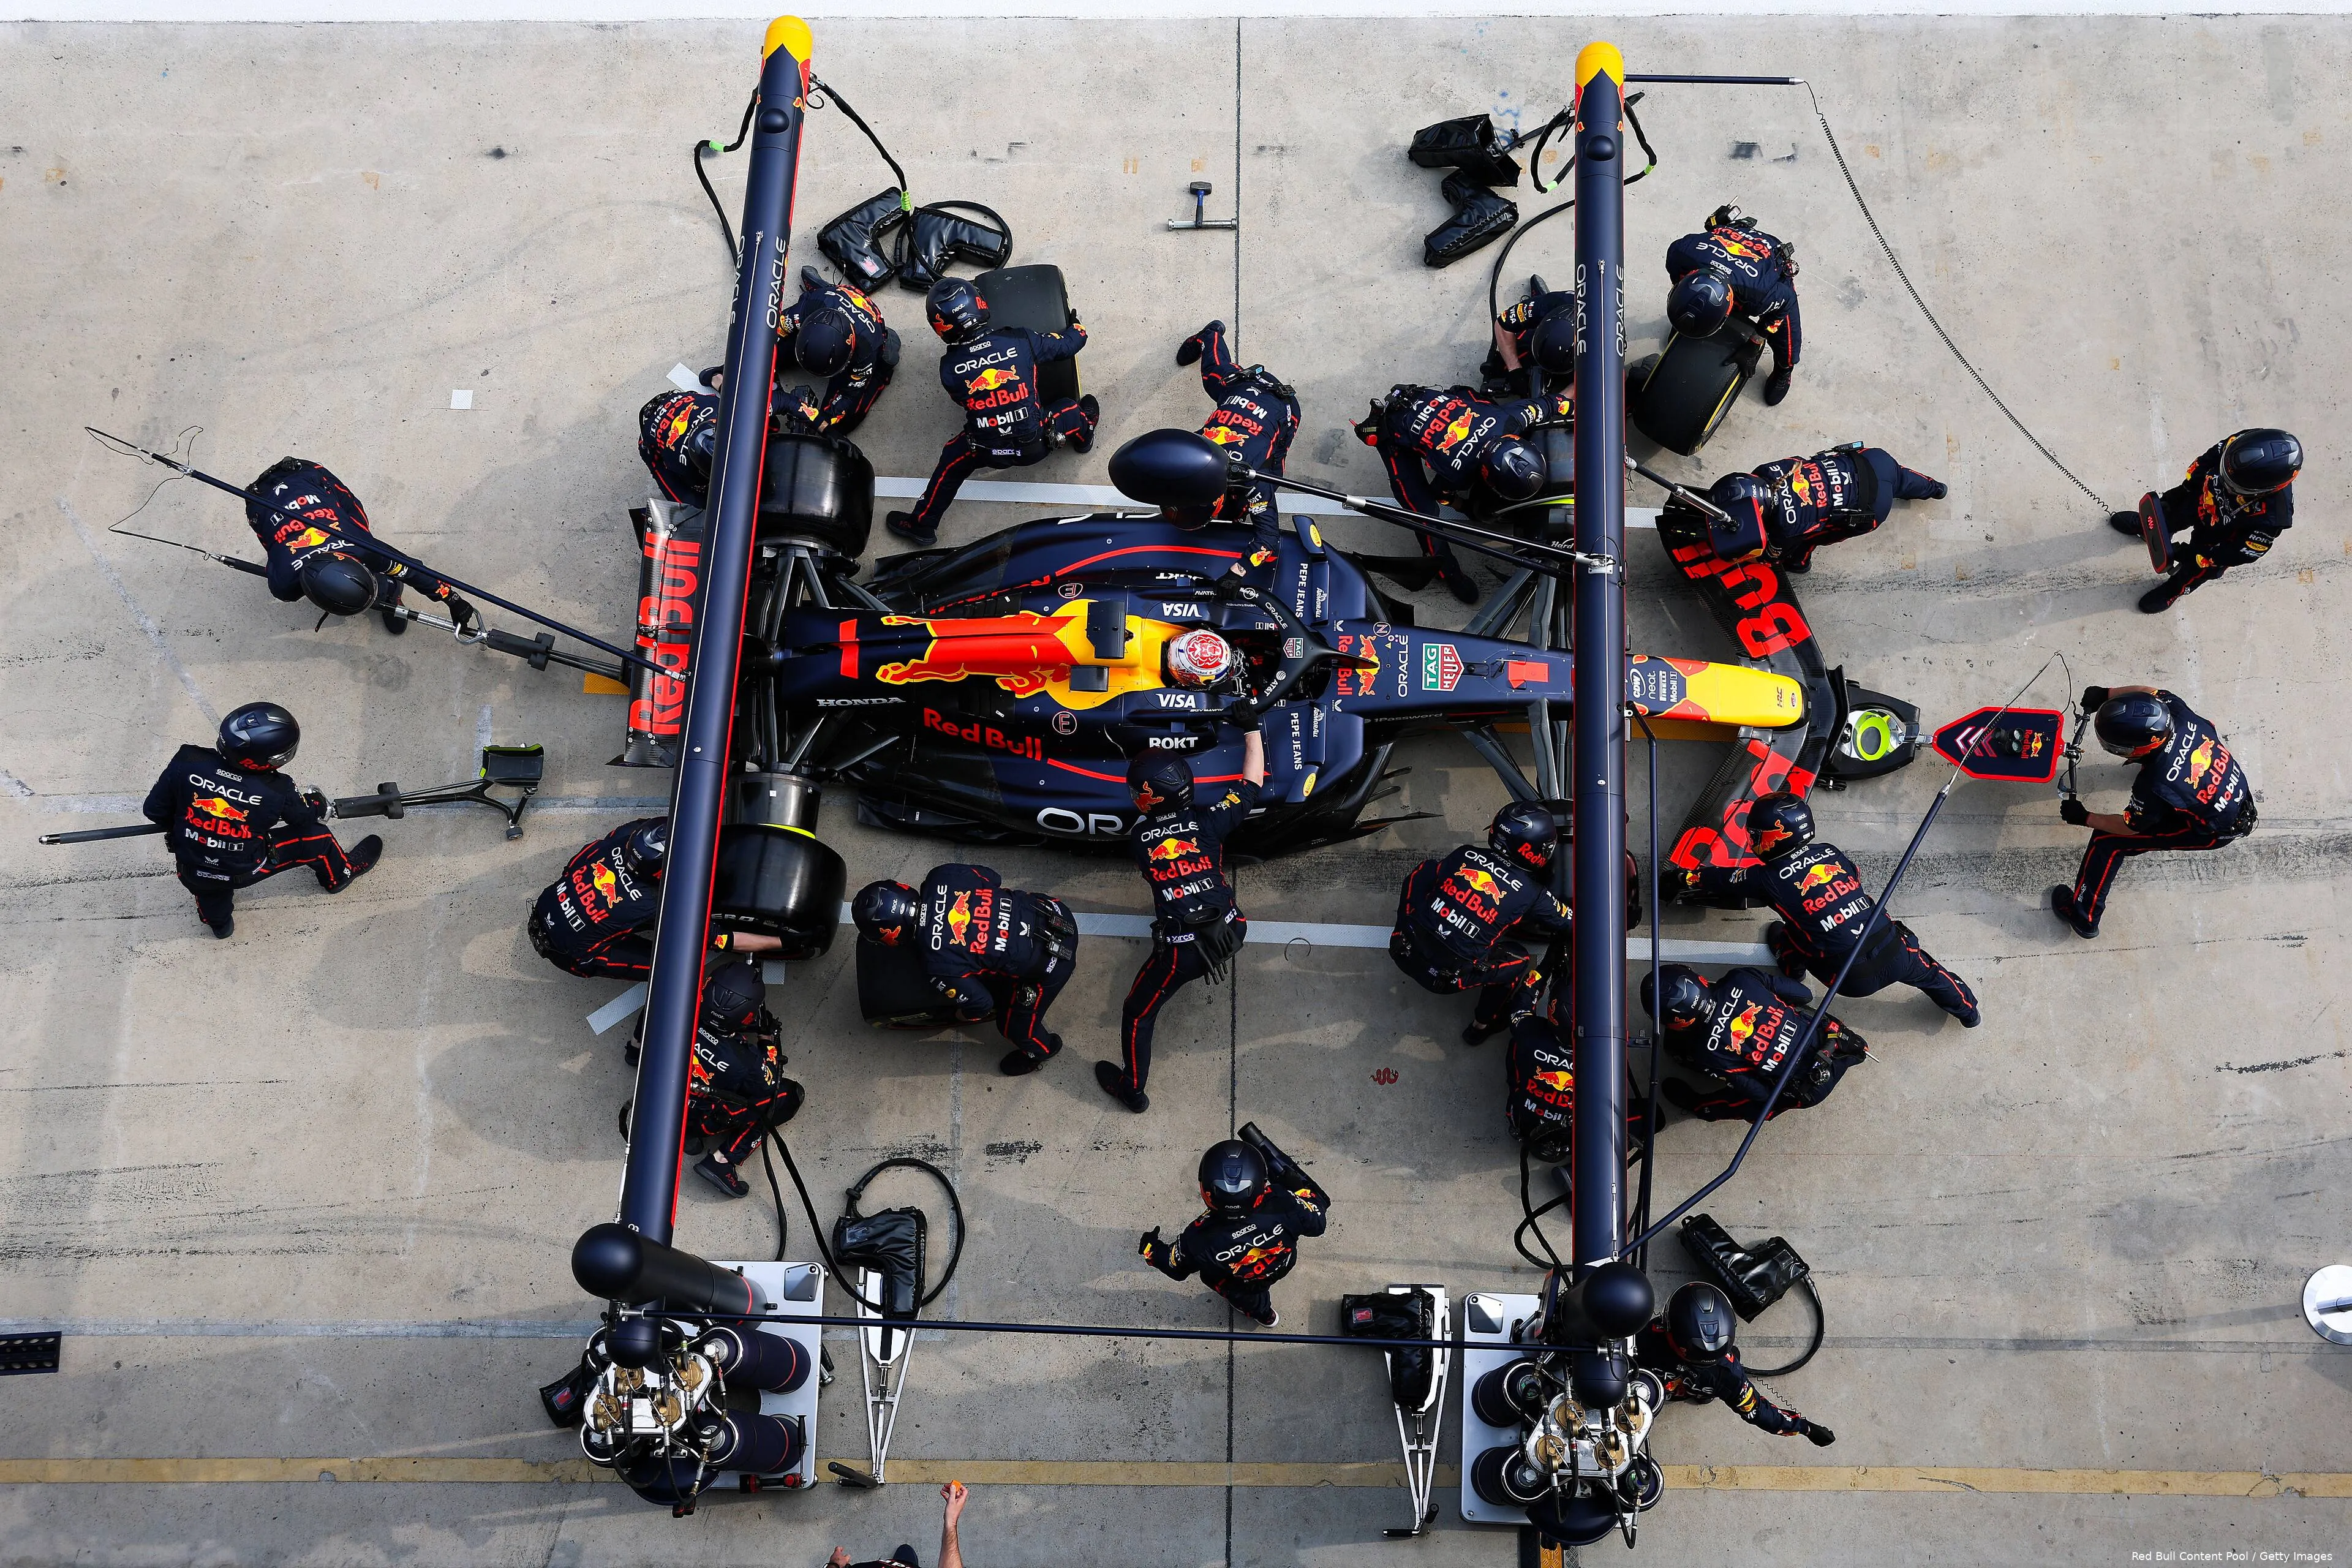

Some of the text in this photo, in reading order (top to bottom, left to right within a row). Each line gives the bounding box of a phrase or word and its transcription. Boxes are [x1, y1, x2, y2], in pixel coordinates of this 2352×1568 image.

[1696, 241, 1758, 278] ORACLE
[1710, 260, 1732, 275] sparco
[767, 235, 786, 329] ORACLE
[825, 290, 875, 334] ORACLE
[975, 296, 989, 309] Re
[1577, 264, 1587, 356] ORACLE
[1615, 265, 1625, 358] ORACLE
[954, 347, 1018, 374] ORACLE
[967, 382, 1030, 411] Red Bull
[1230, 395, 1268, 420] Mobil
[1417, 394, 1450, 421] Mobil
[976, 411, 1014, 428] Mobil
[1227, 413, 1263, 436] Red
[1451, 417, 1496, 470] ORACLE
[1803, 462, 1827, 508] Red Bull
[1826, 468, 1844, 507] Mobil
[1295, 564, 1308, 618] PEPE JEANS
[1162, 603, 1202, 617] VISA
[1265, 602, 1288, 630] ORACLE
[1398, 635, 1408, 697] ORACLE
[1426, 648, 1438, 686] TAG
[1155, 693, 1197, 709] VISA
[1264, 679, 1278, 698] AT&T
[1647, 671, 1656, 699] neat.
[817, 696, 905, 707] HONDA
[923, 707, 1041, 761] Red Bull
[1149, 737, 1199, 749] ROKT
[1291, 712, 1302, 770] PEPE JEANS
[2166, 721, 2197, 782] ORACLE
[189, 774, 263, 805] ORACLE
[216, 768, 243, 782] sparco
[2196, 768, 2222, 804] Red
[2214, 774, 2239, 812] Mobil
[185, 807, 252, 839] Red Bull
[185, 828, 226, 849] Mobil
[1141, 821, 1199, 842] ORACLE
[612, 847, 643, 901] ORACLE
[1150, 855, 1213, 881] Red Bull
[1464, 850, 1523, 892] ORACLE
[1779, 848, 1836, 880] ORACLE
[557, 881, 576, 919] Mobil
[572, 865, 609, 924] Red Bull
[1163, 882, 1198, 902] Mobil
[1441, 878, 1499, 924] Red Bull
[1802, 888, 1836, 915] Red
[931, 884, 948, 951] ORACLE
[970, 888, 992, 954] Red Bull
[1431, 897, 1468, 929] Mobil
[1820, 902, 1858, 933] Mobil
[995, 912, 1011, 952] Mobil
[1707, 986, 1743, 1052] ORACLE
[1757, 1005, 1785, 1041] Bull
[694, 1042, 729, 1072] ACLE
[1762, 1040, 1793, 1072] Mobil
[1525, 1098, 1562, 1120] Mobil
[1216, 1224, 1284, 1261] ORACLE
[1232, 1224, 1257, 1239] sparco
